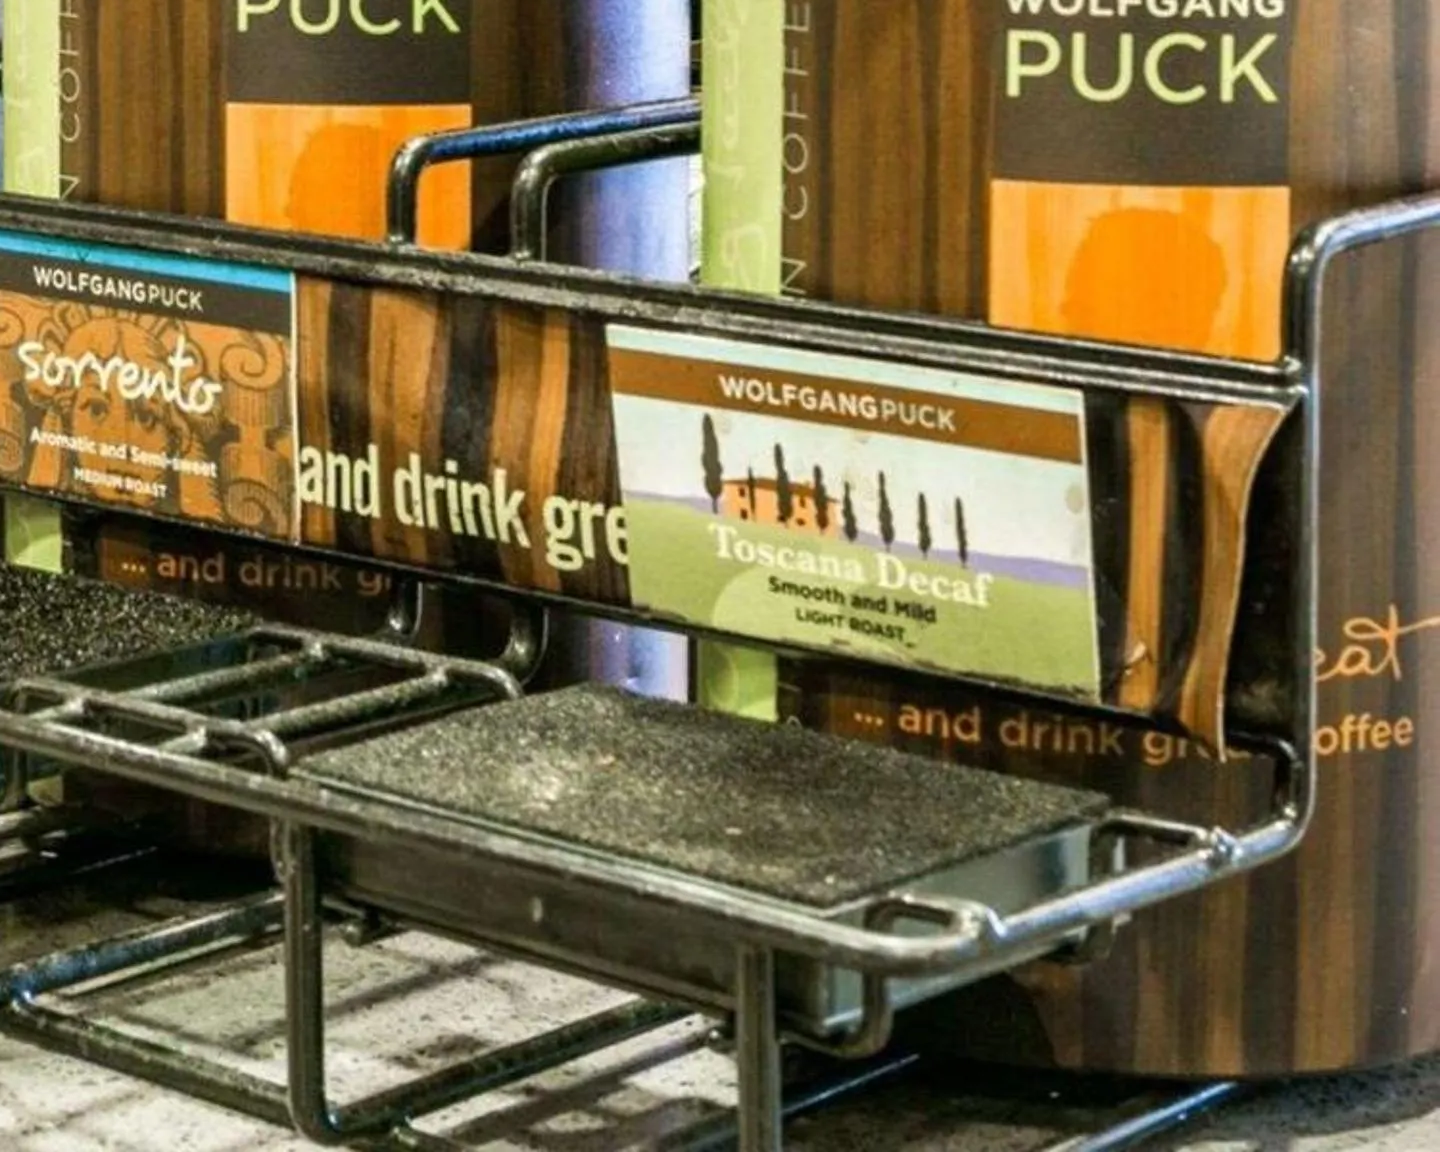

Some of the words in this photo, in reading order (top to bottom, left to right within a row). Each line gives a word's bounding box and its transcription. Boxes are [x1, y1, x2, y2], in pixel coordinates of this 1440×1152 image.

[1005, 30, 1278, 104] PUCK
[29, 425, 97, 454] Aromatic
[100, 441, 127, 461] and
[74, 466, 124, 487] MEDIUM
[125, 476, 168, 498] ROAST
[299, 443, 381, 519] and
[393, 451, 531, 548] drink
[543, 494, 630, 571] gre
[157, 551, 225, 584] and
[238, 552, 343, 590] drink
[707, 523, 866, 582] Toscana
[876, 552, 995, 607] Decaf
[767, 575, 847, 606] Smooth
[850, 592, 888, 614] and
[894, 599, 938, 624] Mild
[795, 607, 844, 628] LIGHT
[848, 619, 906, 642] ROAST
[898, 705, 981, 743] and
[999, 709, 1124, 756] drink
